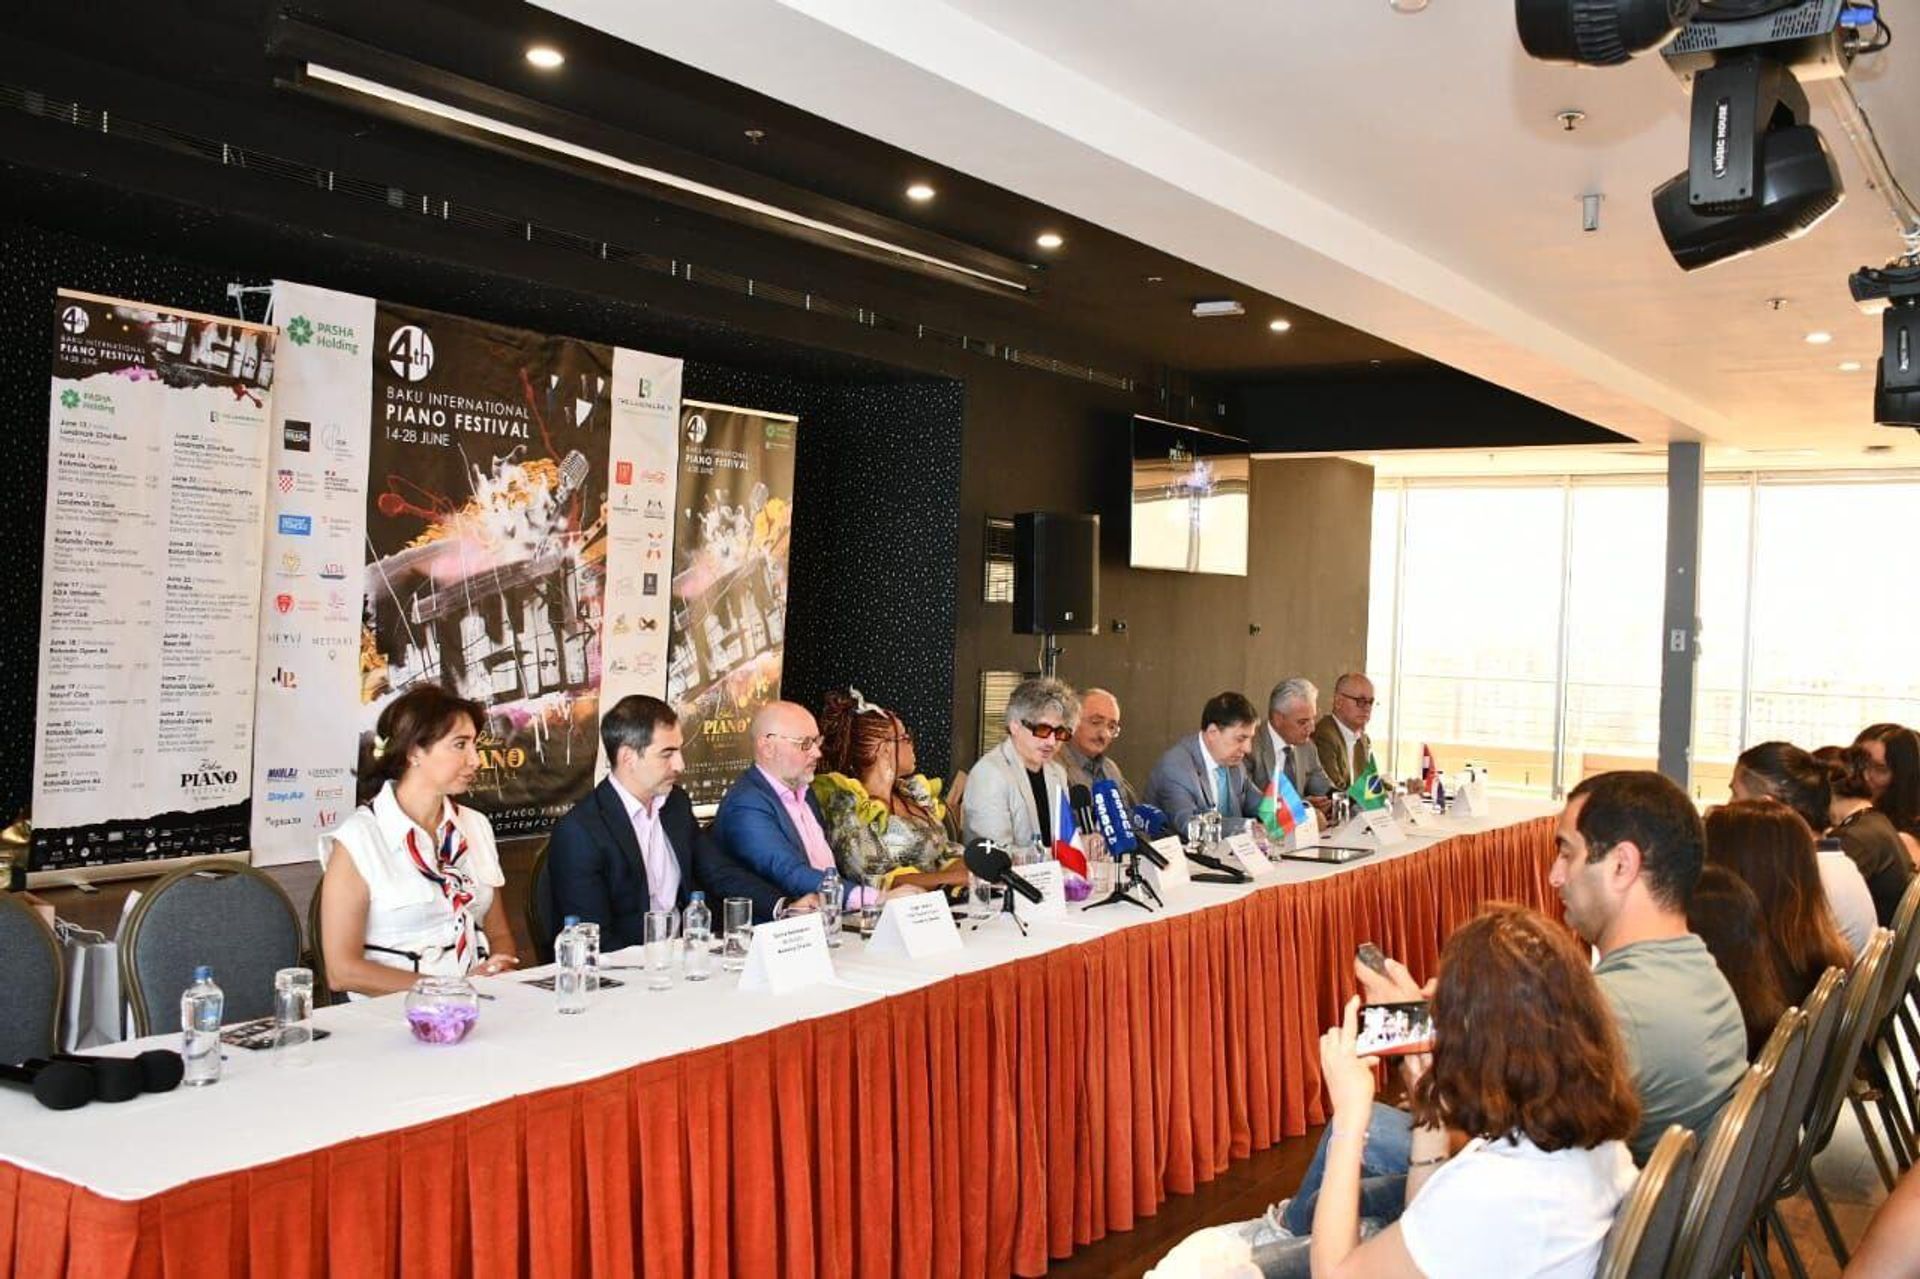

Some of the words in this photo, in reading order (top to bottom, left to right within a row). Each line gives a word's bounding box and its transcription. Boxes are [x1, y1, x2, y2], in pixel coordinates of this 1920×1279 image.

[1717, 104, 1728, 138] HOUSE
[1715, 139, 1725, 171] MUSIC
[317, 322, 354, 337] PASHA
[60, 343, 96, 357] PIANO
[99, 348, 146, 364] FESTIVAL
[317, 336, 359, 355] Holding
[388, 326, 432, 381] 4th
[386, 385, 423, 404] BAKU
[428, 392, 529, 420] INTERNATIONAL
[386, 403, 446, 427] PIANO
[454, 413, 530, 439] FESTIVAL
[385, 426, 417, 444] 14-28
[419, 431, 451, 447] JUNE
[685, 454, 713, 466] PIANO
[714, 457, 750, 471] FESTIVAL
[703, 718, 747, 735] PIANO
[477, 747, 526, 769] ANO
[180, 770, 238, 788] PIANO
